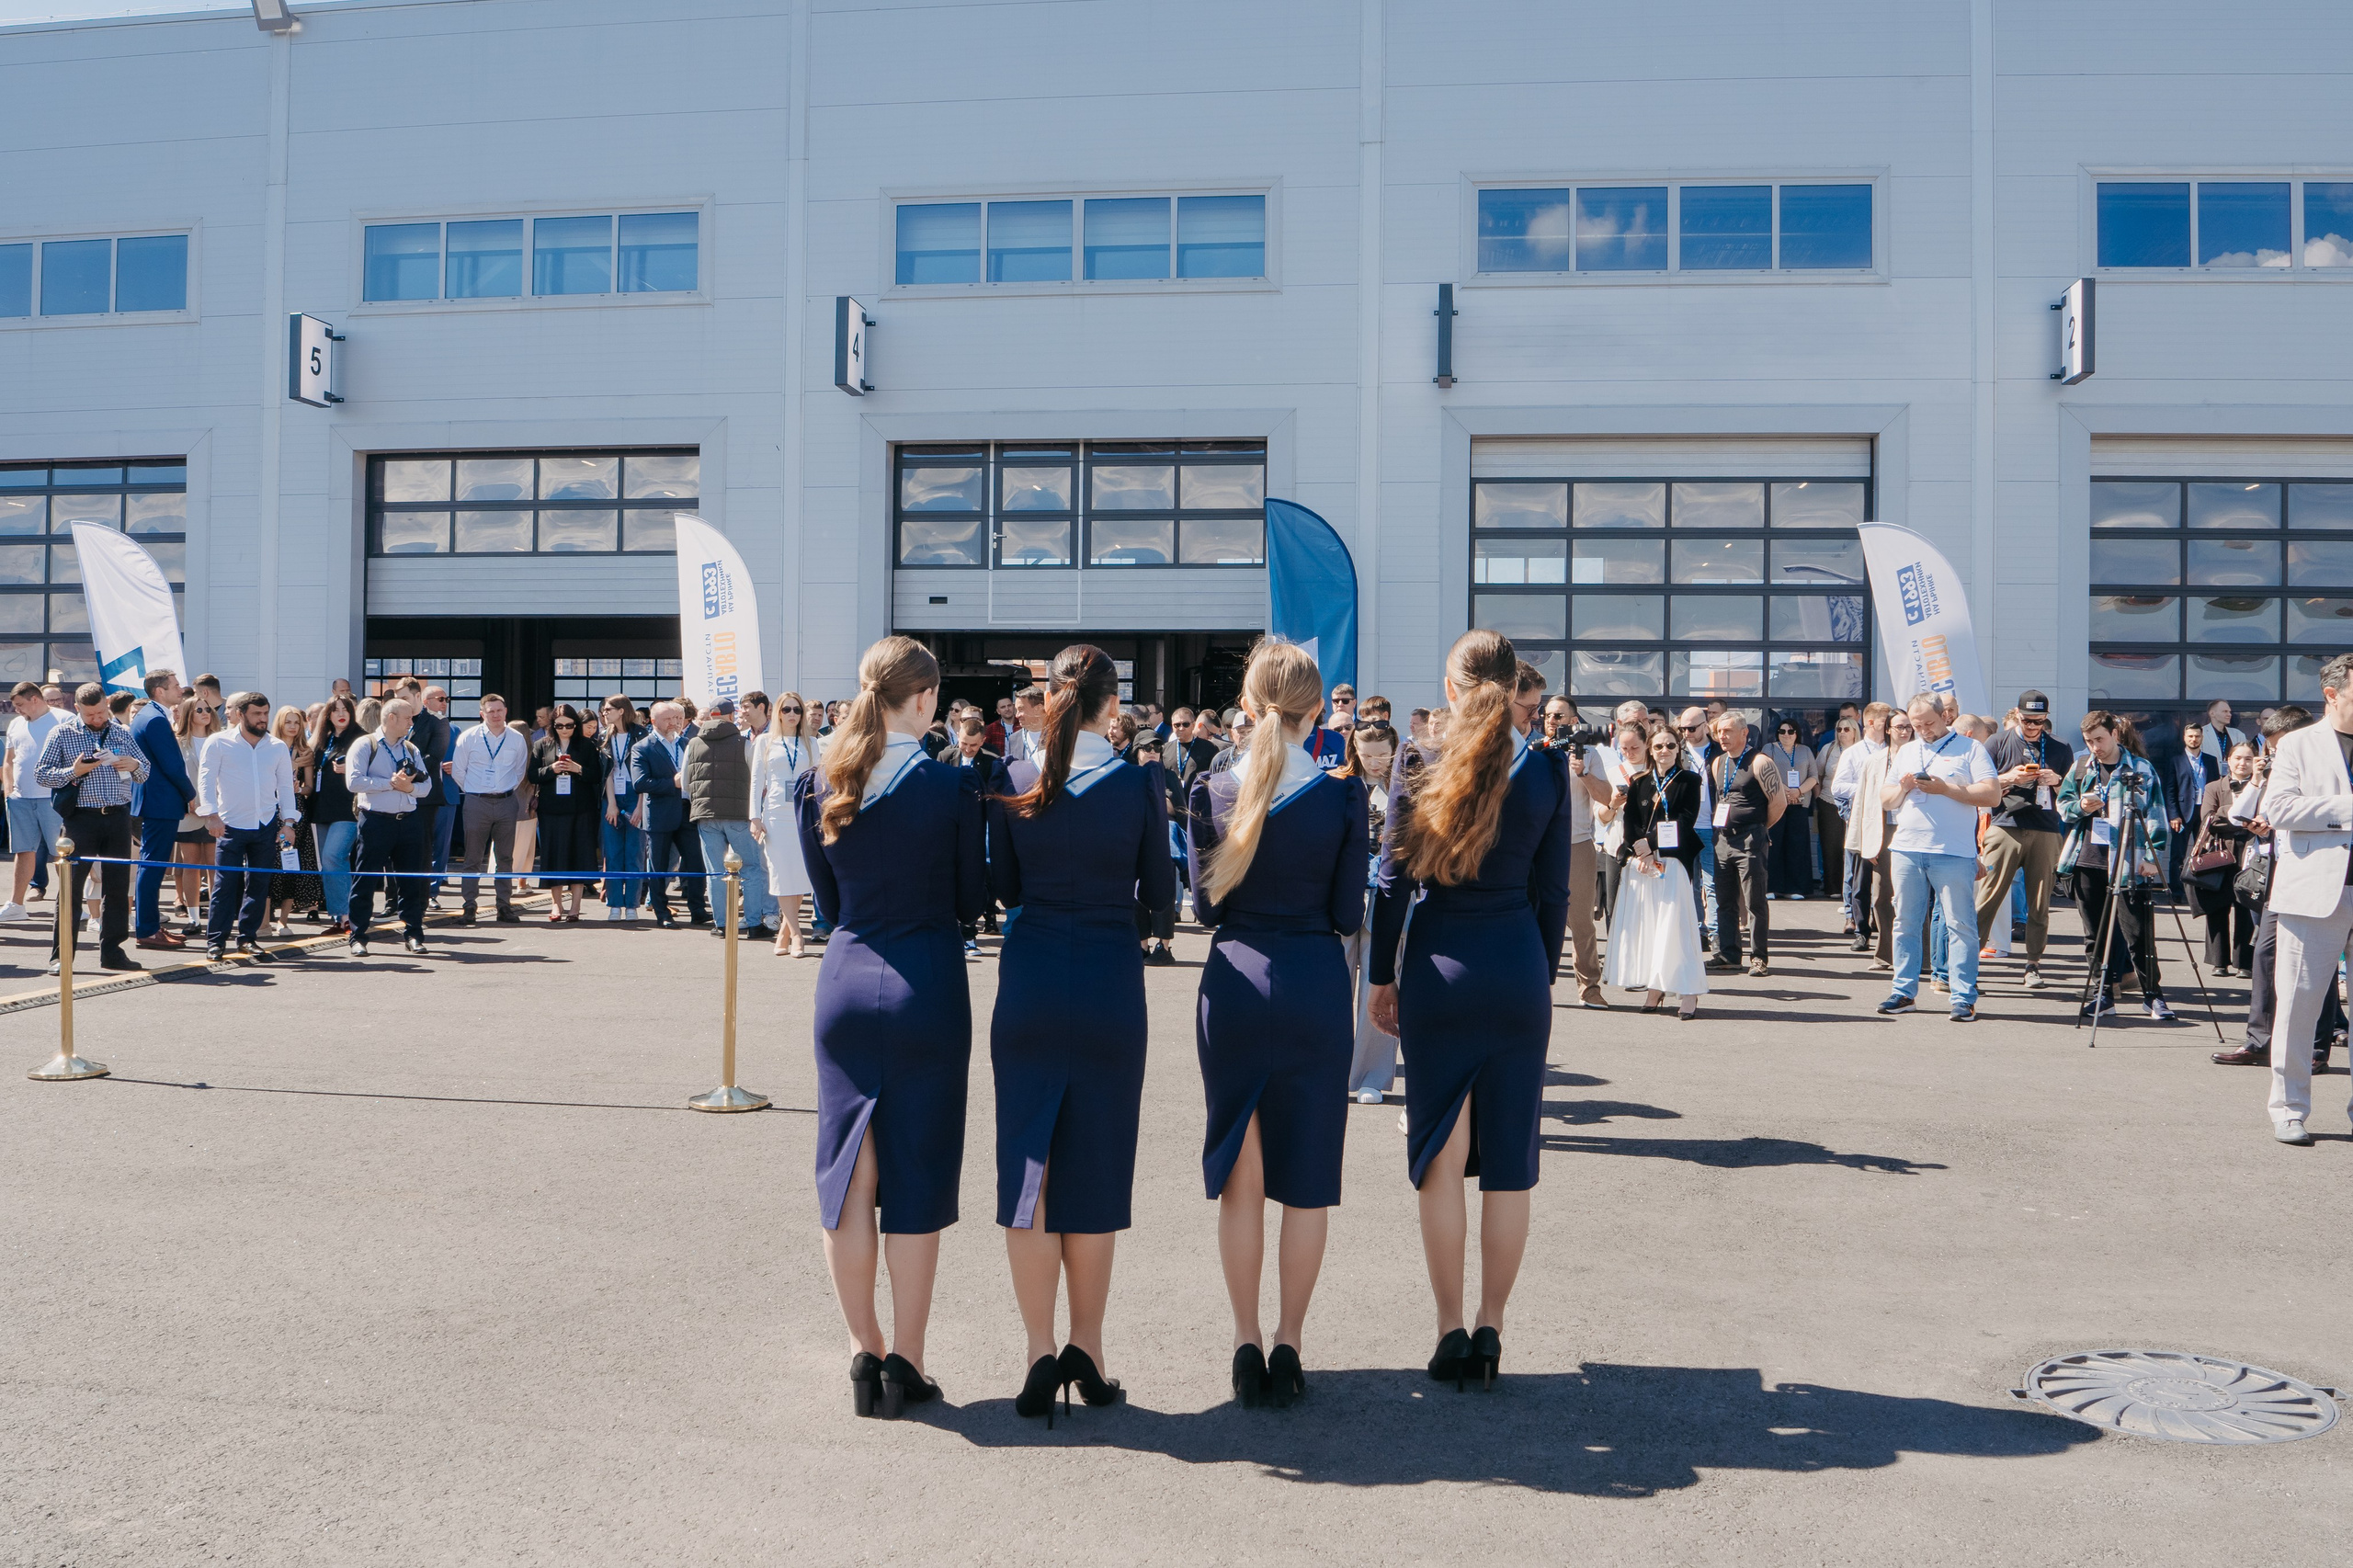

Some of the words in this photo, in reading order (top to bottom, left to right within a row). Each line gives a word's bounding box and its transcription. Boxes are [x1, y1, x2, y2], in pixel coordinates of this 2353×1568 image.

[853, 333, 859, 362] 4
[2068, 316, 2076, 350] 2
[311, 347, 322, 376] 5
[1549, 737, 1569, 747] RONIN
